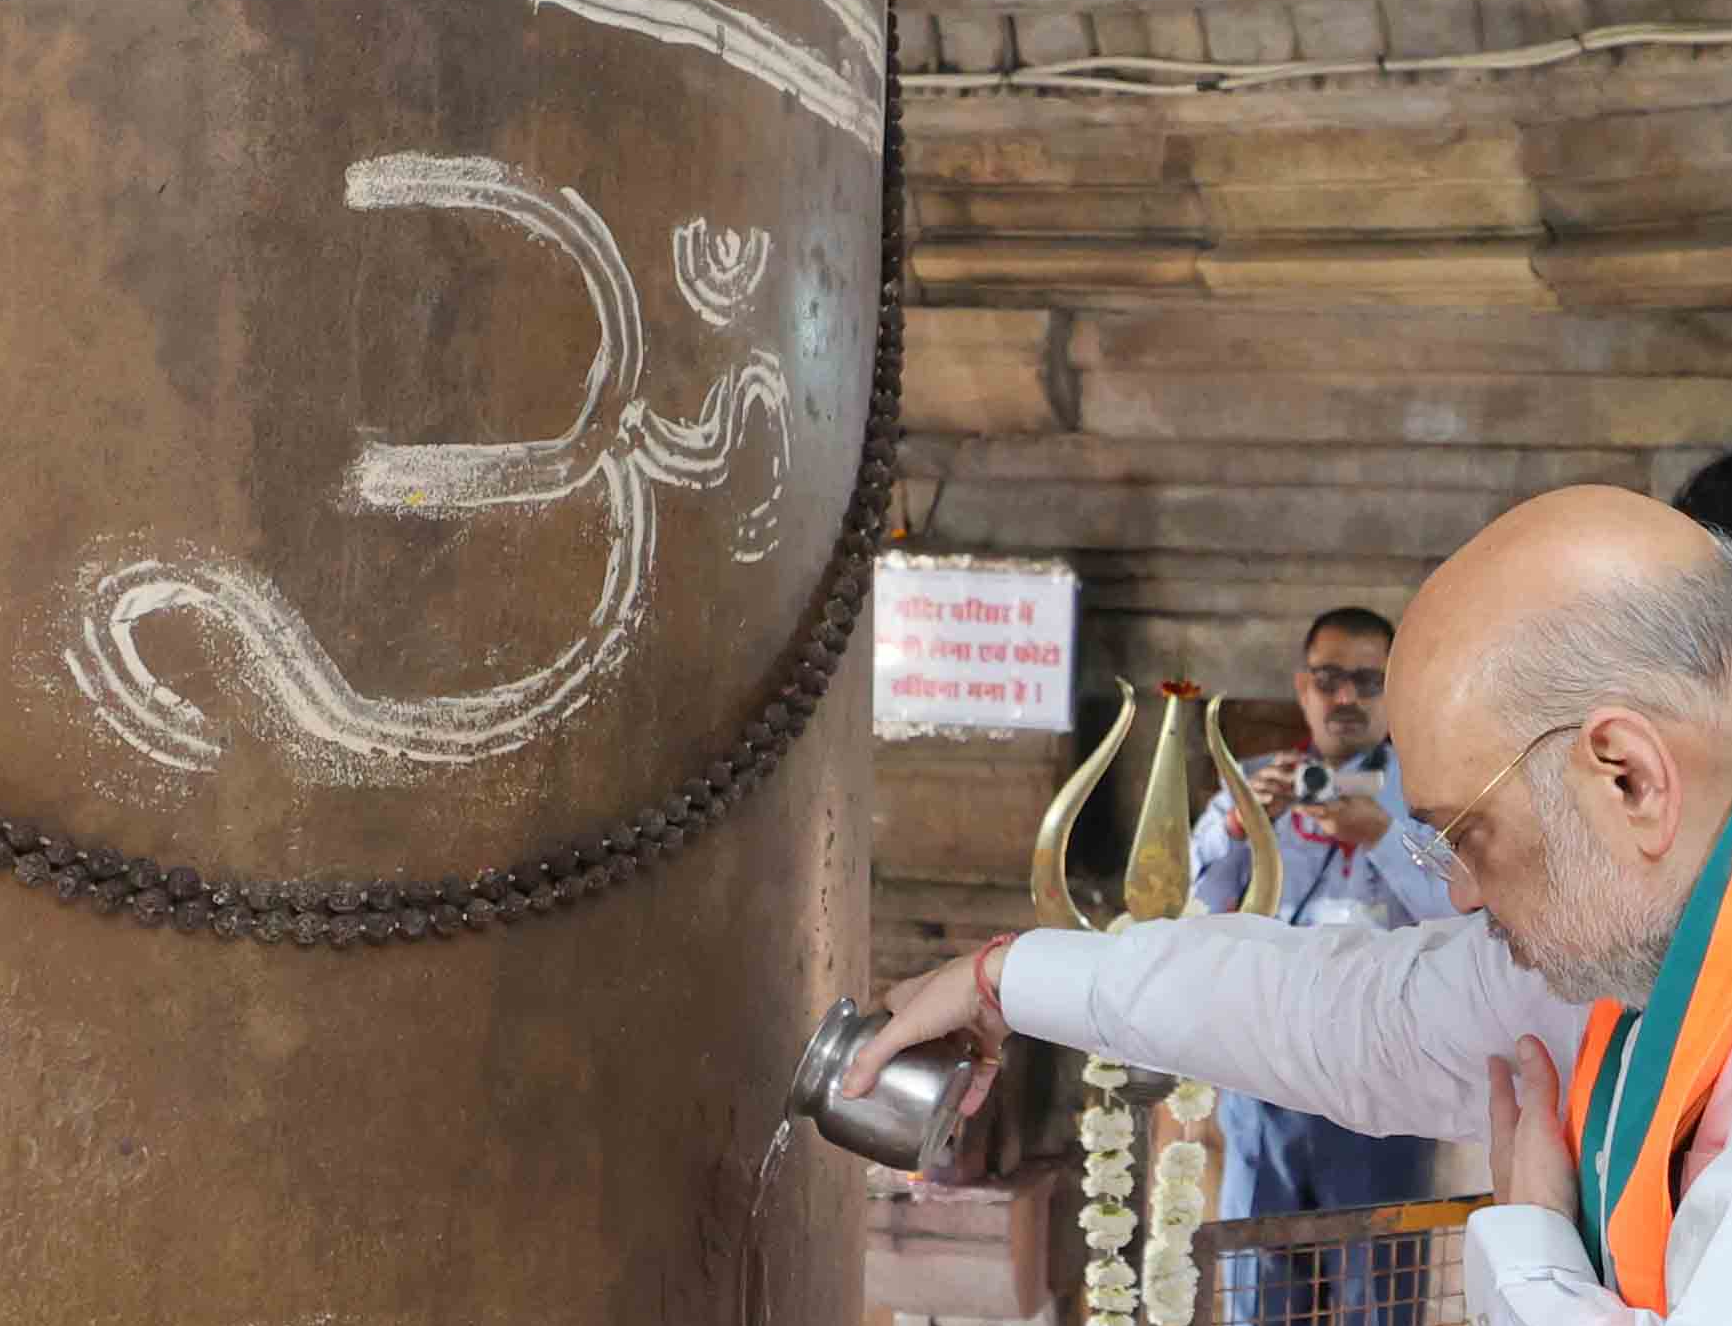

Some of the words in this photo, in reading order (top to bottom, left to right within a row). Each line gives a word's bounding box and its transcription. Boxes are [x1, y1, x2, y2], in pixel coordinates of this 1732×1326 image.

[950, 596, 1012, 624] परिसर
[1014, 640, 1060, 665] फोटो
[966, 682, 1005, 702] मना
[1013, 678, 1027, 704] है
